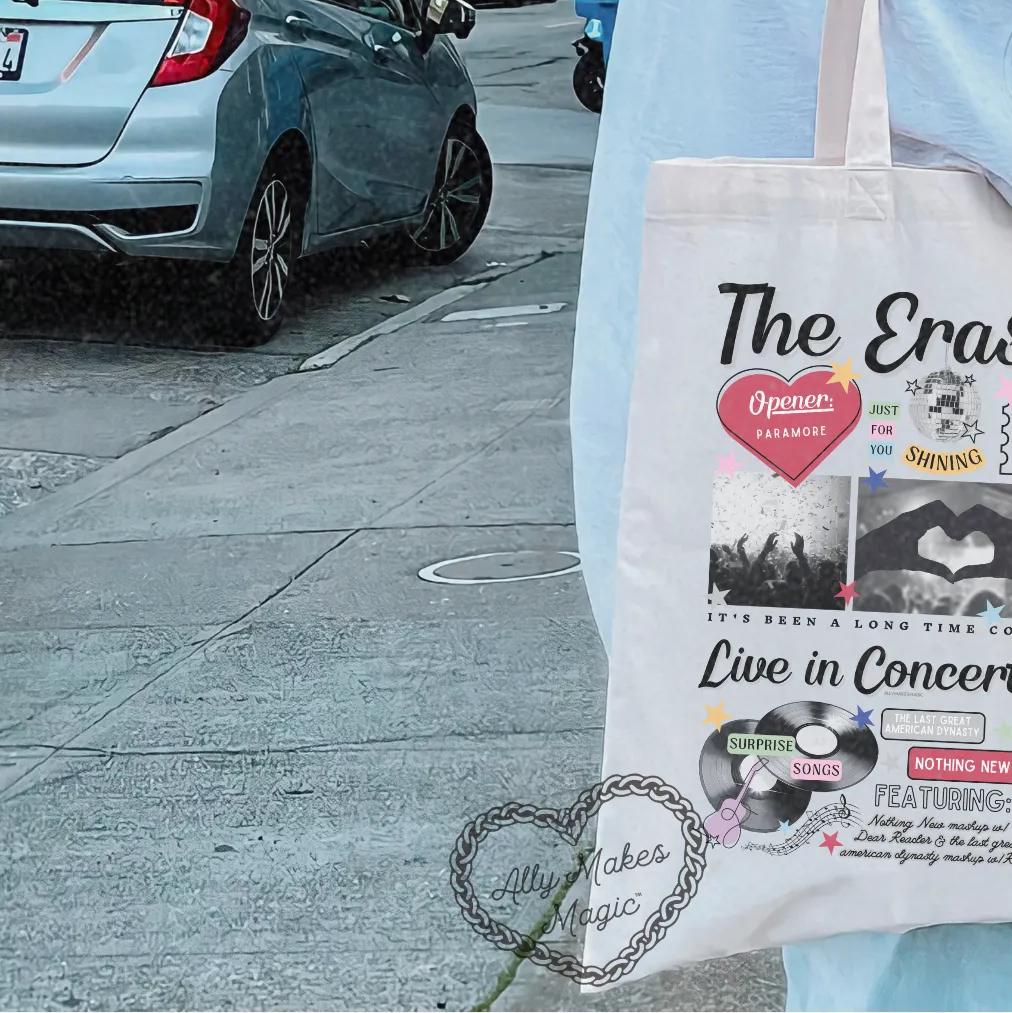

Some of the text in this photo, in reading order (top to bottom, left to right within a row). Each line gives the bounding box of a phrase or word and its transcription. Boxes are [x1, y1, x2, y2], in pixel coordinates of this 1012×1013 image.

[718, 282, 842, 365] The
[749, 390, 835, 419] Opener:
[869, 404, 899, 416] JUST
[756, 425, 827, 439] PARAMORE
[871, 424, 893, 436] FOR
[870, 444, 893, 456] YOU
[905, 445, 983, 472] SHINING
[764, 615, 817, 627] BEEN
[830, 618, 841, 628] A
[854, 619, 910, 631] LONG
[924, 622, 976, 634] TIME
[698, 638, 793, 689] Live
[804, 650, 845, 687] in
[894, 713, 972, 726] THE LAST GREAT
[884, 723, 980, 737] AMERICAN DYNASTY
[729, 737, 793, 752] SURPRISE
[792, 762, 840, 777] SONGS
[915, 756, 1011, 774] NOTHING NEW
[874, 784, 1012, 814] FEATURING:
[868, 814, 914, 833] Nothing
[917, 816, 945, 829] New
[947, 820, 989, 834] mashup
[853, 829, 886, 843] Dear
[888, 830, 932, 845] Reader
[934, 834, 946, 848] &
[949, 835, 966, 846] the
[967, 836, 990, 847] last
[839, 849, 892, 859] american
[894, 849, 940, 866] dynasty
[942, 852, 984, 865] mashup
